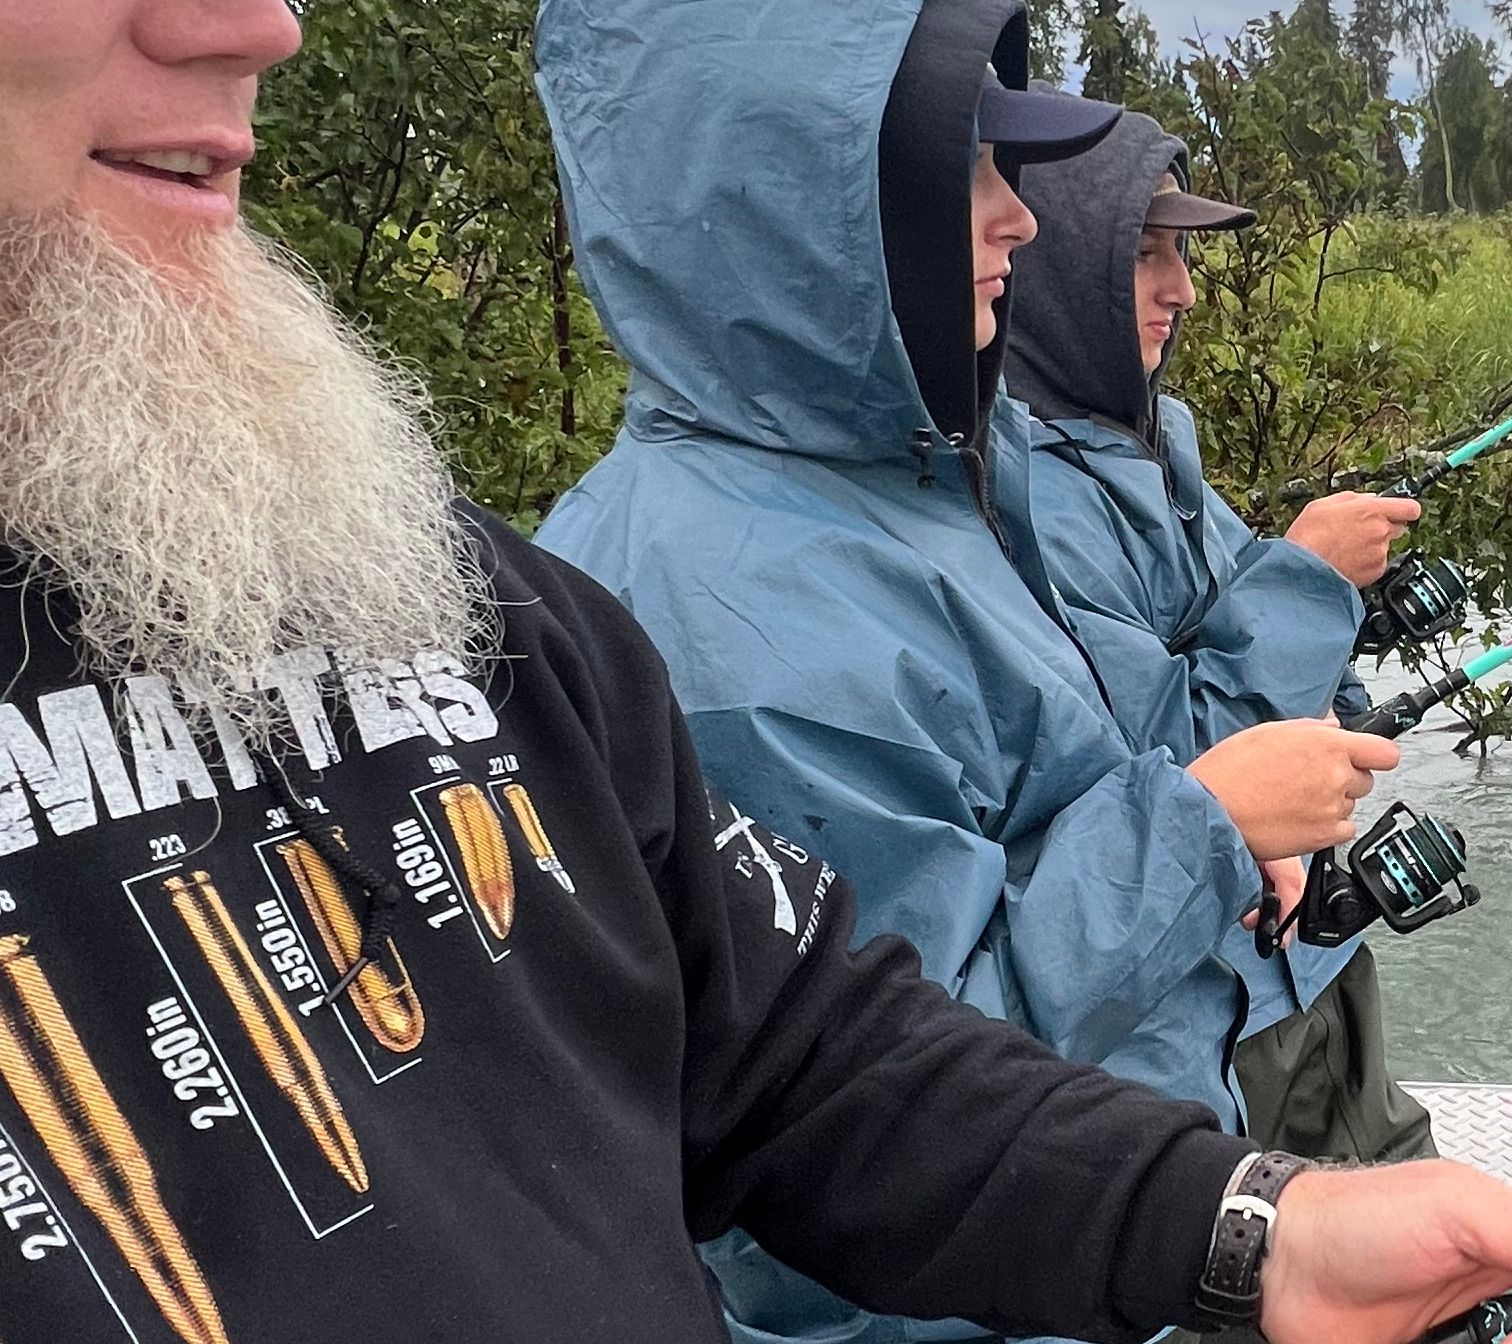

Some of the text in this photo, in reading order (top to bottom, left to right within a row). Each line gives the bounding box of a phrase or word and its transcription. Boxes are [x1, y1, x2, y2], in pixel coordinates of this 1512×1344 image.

[149, 834, 188, 861] .223
[392, 818, 464, 929] 1.169in
[254, 899, 326, 1017] 1.550in
[146, 996, 240, 1130] 2.260in
